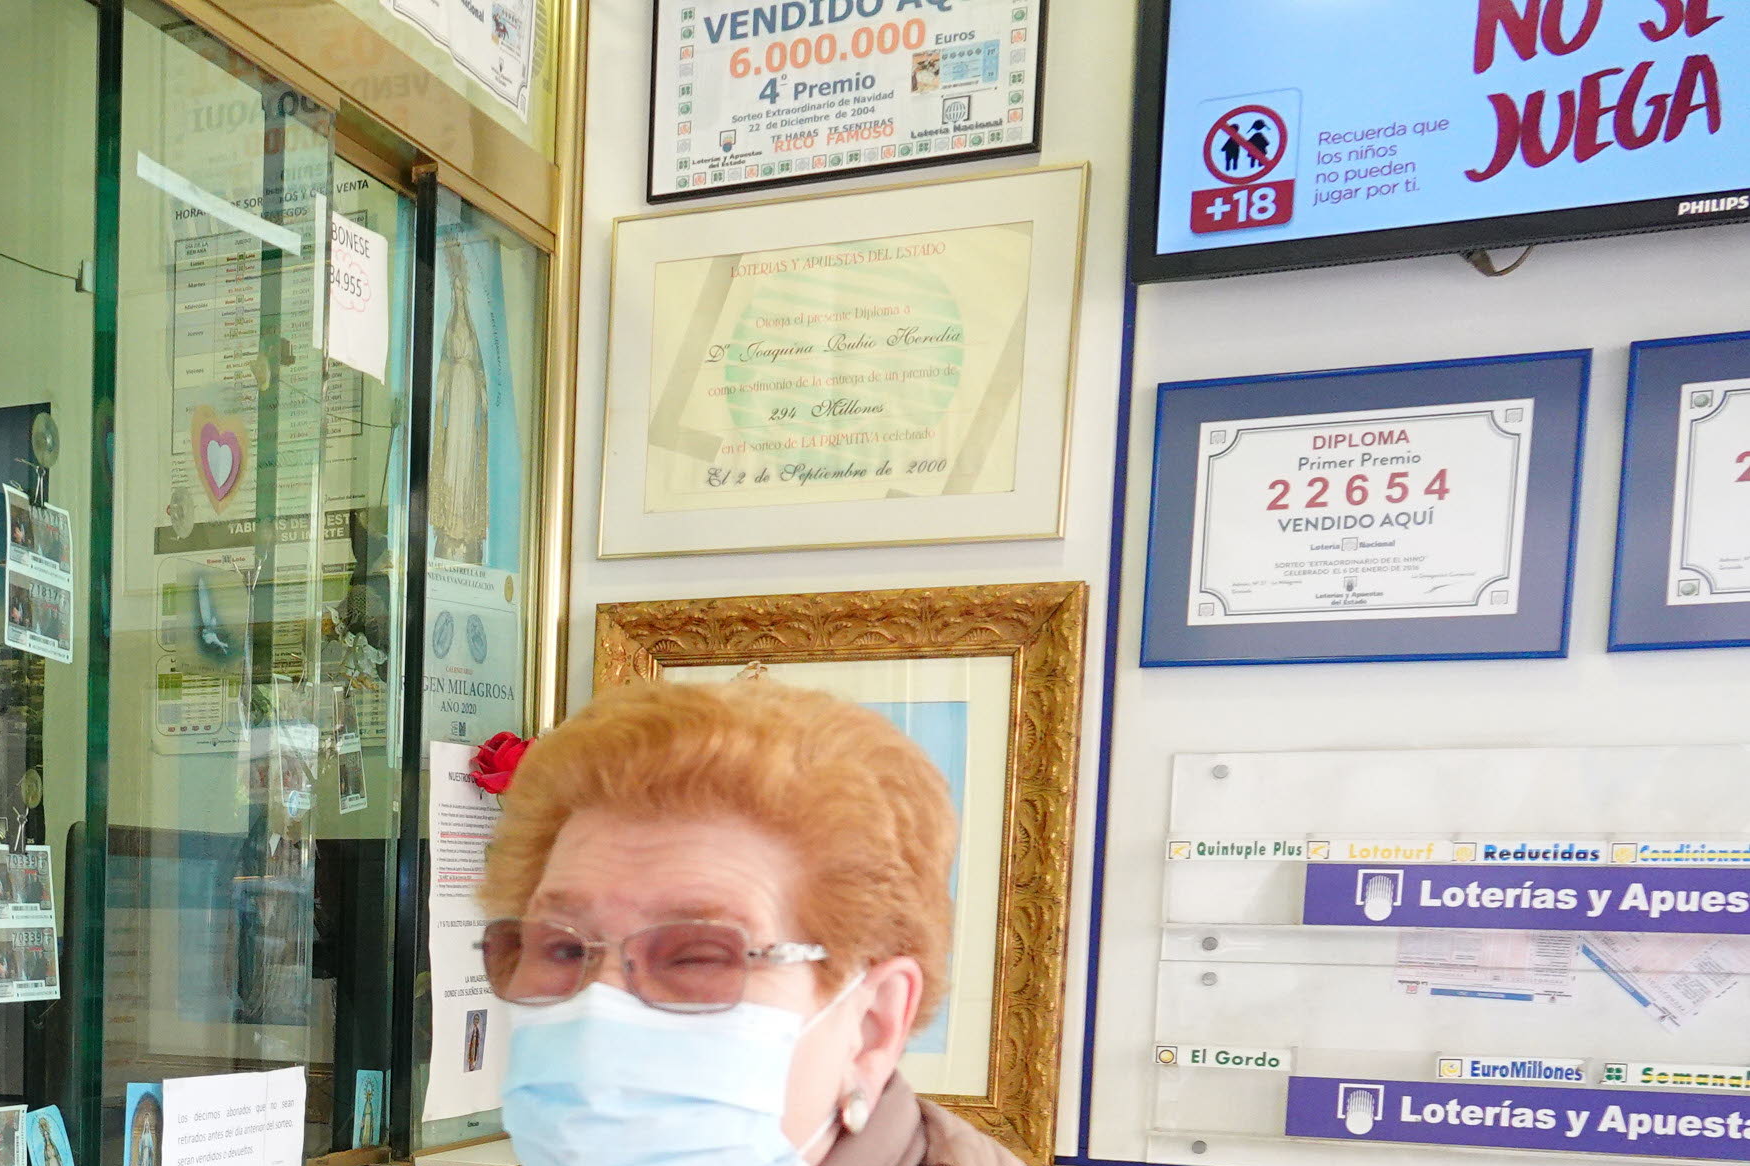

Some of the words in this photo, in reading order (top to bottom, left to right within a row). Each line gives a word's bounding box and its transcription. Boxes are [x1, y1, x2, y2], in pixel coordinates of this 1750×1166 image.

[704, 0, 883, 44] VENDIDO
[730, 18, 926, 78] 6.000.000
[935, 30, 976, 45] Euros
[1473, 0, 1603, 74] NO
[794, 72, 876, 100] Premio
[731, 113, 763, 124] Sorteo
[765, 101, 835, 119] Extraordinario
[838, 97, 850, 107] de
[853, 90, 895, 105] Navidad
[748, 123, 761, 133] 22
[766, 120, 778, 130] de
[780, 113, 830, 128] Diciembre
[835, 108, 847, 119] de
[850, 105, 876, 117] 2004
[1464, 54, 1722, 182] JUEGA
[842, 117, 894, 132] SENTIRAS
[1318, 121, 1407, 146] Recuerda
[1413, 118, 1450, 136] que
[773, 136, 815, 153] RICO
[826, 125, 895, 146] FAMOSO
[1316, 150, 1342, 166] los
[1348, 144, 1397, 161] niños
[1315, 171, 1339, 184] no
[1344, 160, 1416, 183] pueden
[336, 179, 369, 193] VENTA
[1312, 185, 1361, 207] jugar
[1366, 184, 1400, 200] por
[1404, 177, 1420, 192] ti.
[1205, 187, 1277, 223] +18
[1677, 194, 1749, 216] PHILIPS
[792, 258, 800, 270] Y
[803, 252, 865, 269] APUESTAS
[868, 248, 892, 261] DEL
[895, 242, 946, 259] ESTADO
[739, 340, 814, 364] Joaquina
[823, 332, 877, 353] Rubio
[886, 325, 961, 347] Heredia
[768, 405, 797, 421] 294
[811, 398, 885, 418] Millones
[1312, 429, 1410, 450] DIPLOMA
[736, 471, 745, 485] 2
[754, 468, 770, 484] de
[779, 462, 867, 487] Septiembre
[875, 460, 892, 476] de
[906, 458, 947, 475] 2000
[1298, 456, 1354, 471] Primer
[1361, 451, 1421, 468] Premio
[1278, 513, 1375, 532] VENDIDO
[1380, 507, 1434, 528] AQUÍ
[1359, 539, 1396, 549] Nacional
[448, 678, 515, 701] MILAGROSA
[440, 698, 459, 713] AÑO
[461, 703, 477, 715] 2020
[1196, 840, 1266, 859] Quintuple
[1273, 842, 1302, 857] Plus
[1349, 843, 1435, 860] Lototurf
[1484, 844, 1600, 862] Reducidas
[1419, 880, 1577, 910] Loterías
[1586, 889, 1612, 917] y
[1618, 883, 1750, 918] Apues
[1191, 1049, 1207, 1065] El
[1215, 1049, 1281, 1069] Gordo
[1470, 1060, 1585, 1081] EuroMillones
[177, 1114, 188, 1124] Los
[226, 1105, 251, 1118] abonados
[255, 1104, 266, 1114] que
[270, 1102, 277, 1110] no
[281, 1099, 295, 1108] sean
[1400, 1096, 1557, 1130] Loterías
[1565, 1110, 1590, 1138] y
[177, 1134, 207, 1145] retirados
[208, 1130, 224, 1141] antes
[225, 1128, 234, 1138] del
[244, 1123, 265, 1135] anterior
[266, 1120, 275, 1130] del
[195, 1152, 222, 1163] vendidos
